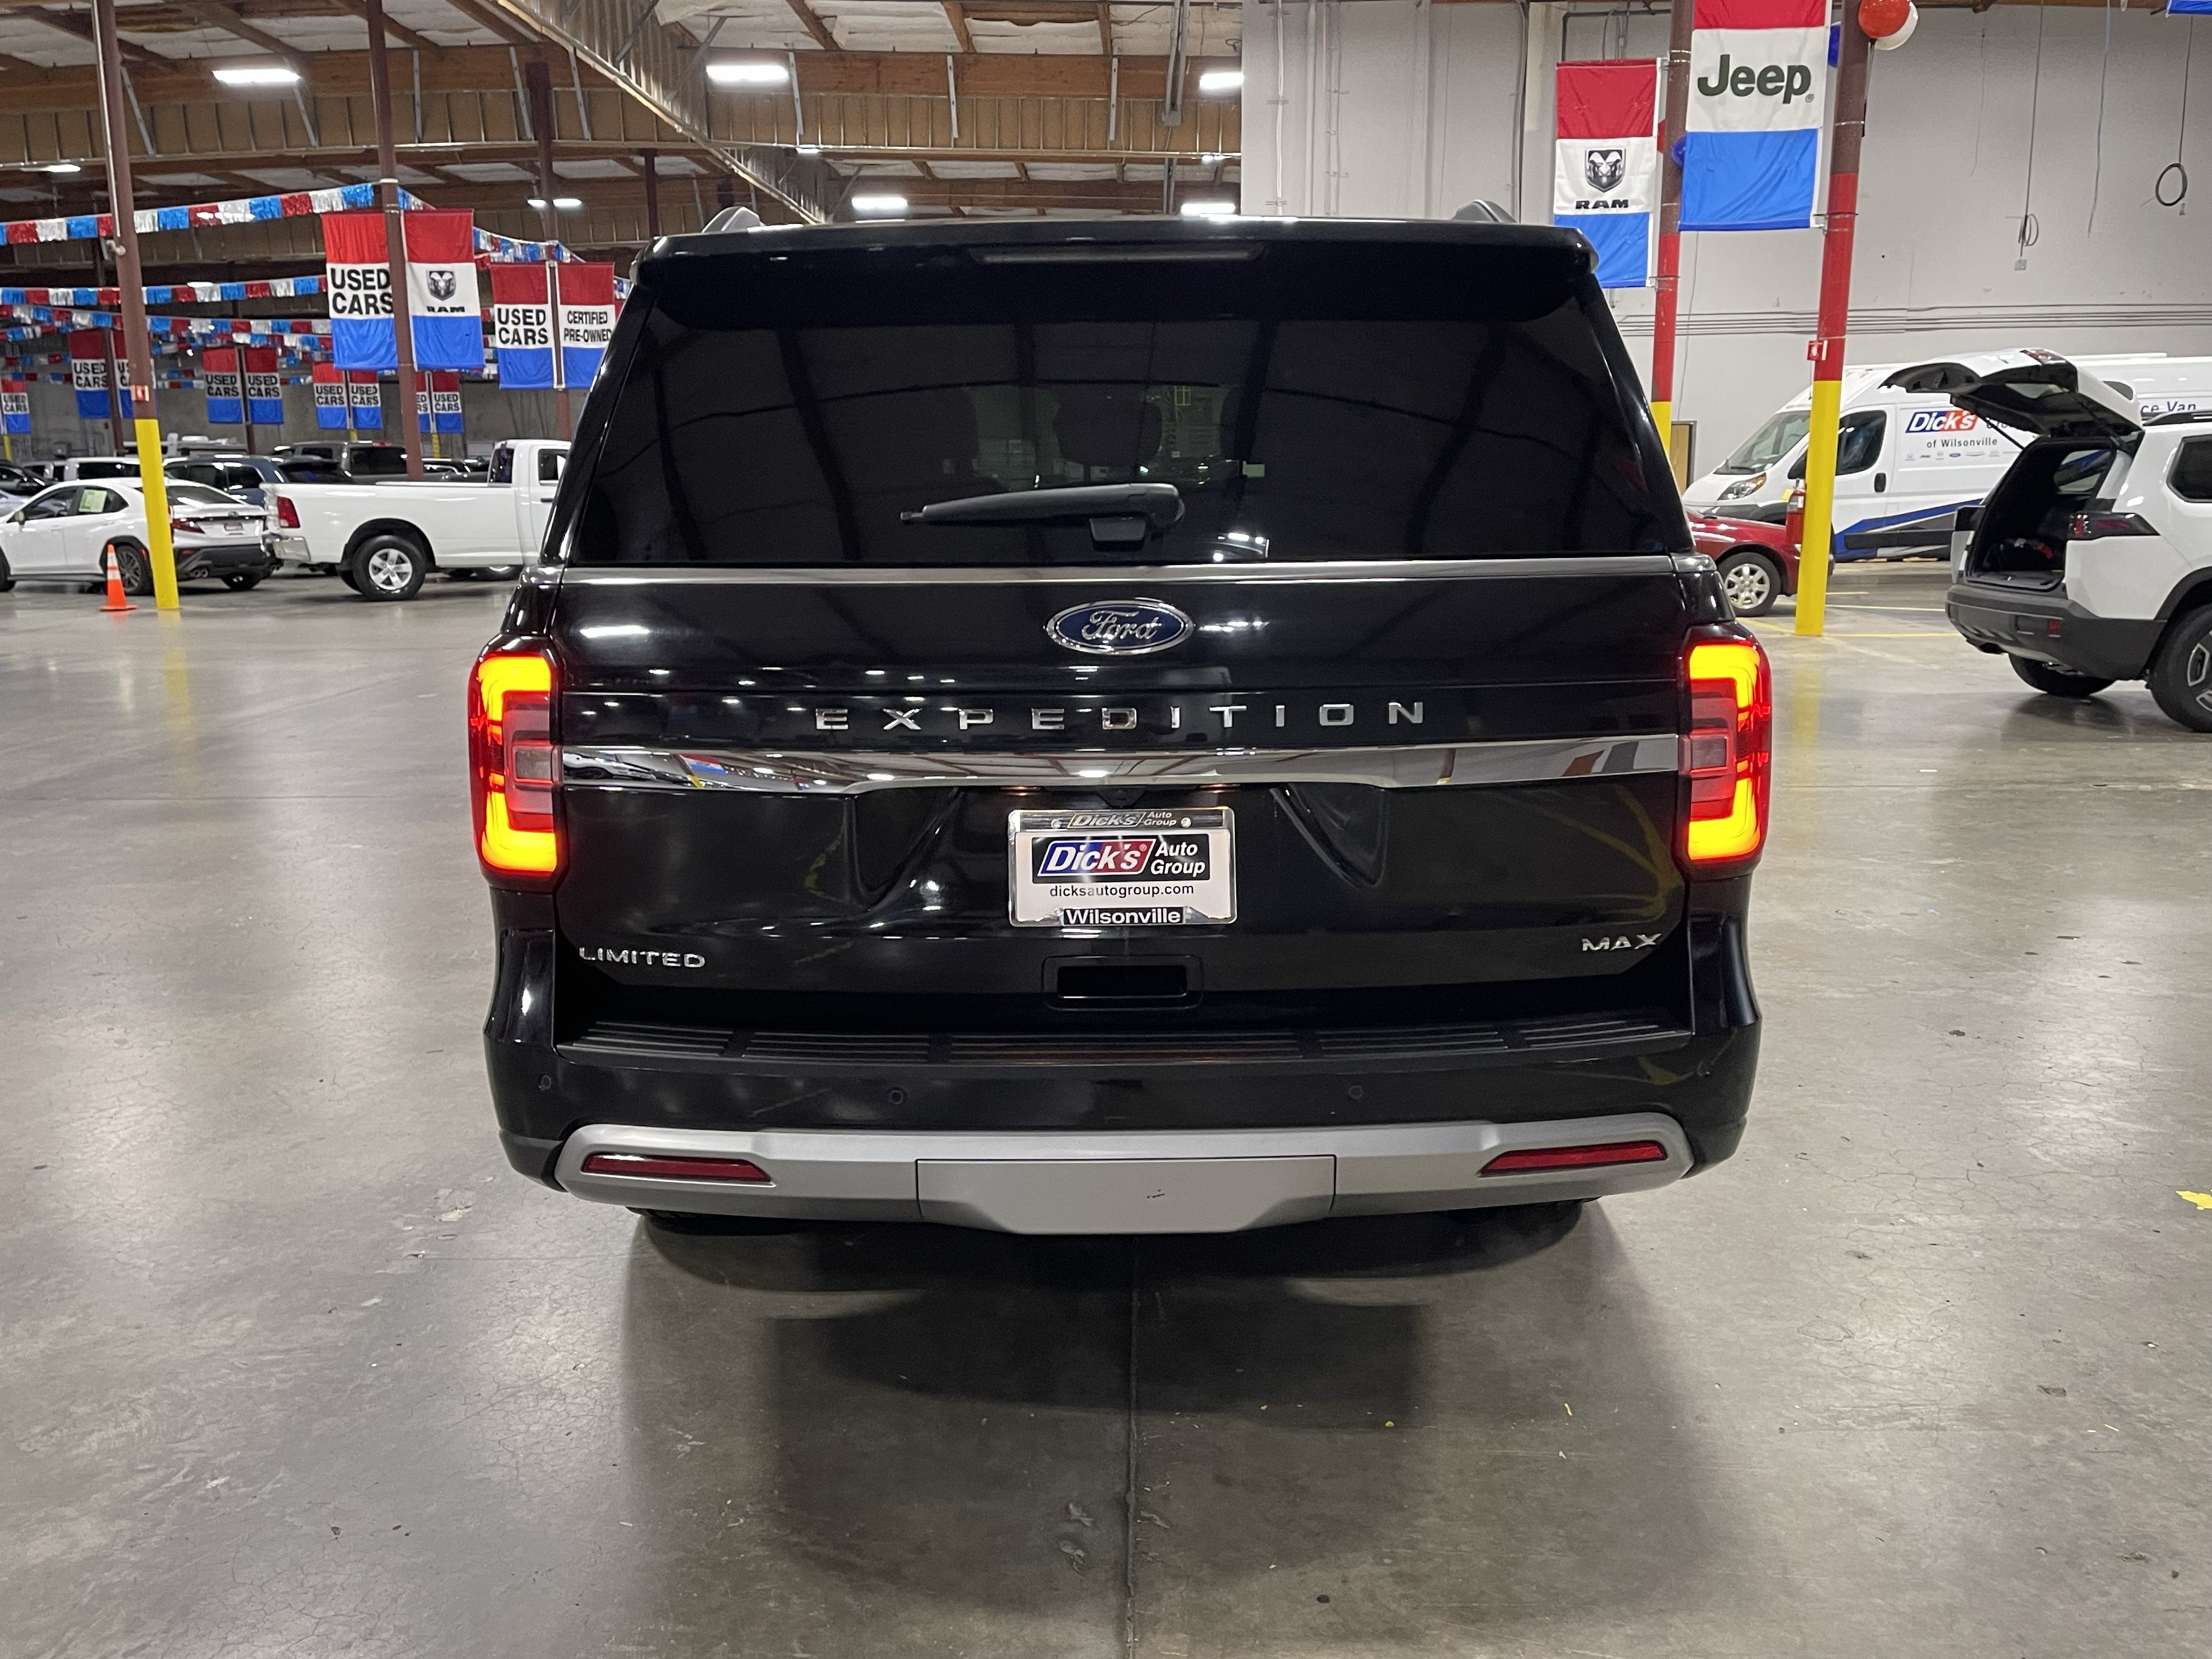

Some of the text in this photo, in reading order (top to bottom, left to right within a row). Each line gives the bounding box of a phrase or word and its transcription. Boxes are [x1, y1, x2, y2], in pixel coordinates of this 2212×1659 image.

[1697, 54, 1812, 104] Jeep
[1575, 199, 1629, 210] RAM
[330, 268, 391, 291] USED
[332, 292, 393, 315] CARS
[497, 308, 546, 326] USED
[567, 310, 608, 325] CERTIFIED
[498, 327, 549, 345] CARS
[563, 328, 613, 343] PRE-OWNED
[74, 362, 106, 374] USED
[76, 376, 109, 388] CARS
[206, 375, 237, 385] USED
[248, 375, 278, 385] USED
[207, 386, 239, 397] CARS
[248, 387, 280, 397] CARS
[316, 385, 343, 395] USED
[351, 386, 377, 395] USED
[317, 396, 345, 405] CARS
[352, 396, 379, 405] CARS
[434, 393, 459, 402] USED
[435, 403, 460, 411] CARS
[2166, 400, 2196, 411] Van
[1909, 410, 1977, 431] Dick's
[1927, 437, 1997, 448] of Wilsonville
[1081, 610, 1163, 641] Ford
[815, 701, 1424, 732] EXPEDITION
[1073, 814, 1138, 827] Dick's
[1144, 818, 1177, 827] Group
[1155, 842, 1198, 857] Auto
[1046, 843, 1142, 871] Dick's
[1150, 859, 1206, 877] Group
[1049, 884, 1194, 898] dicksautogroup.com
[1066, 909, 1181, 925] Wilsonville
[1582, 933, 1662, 951] MAX
[579, 947, 706, 968] LIMITED
